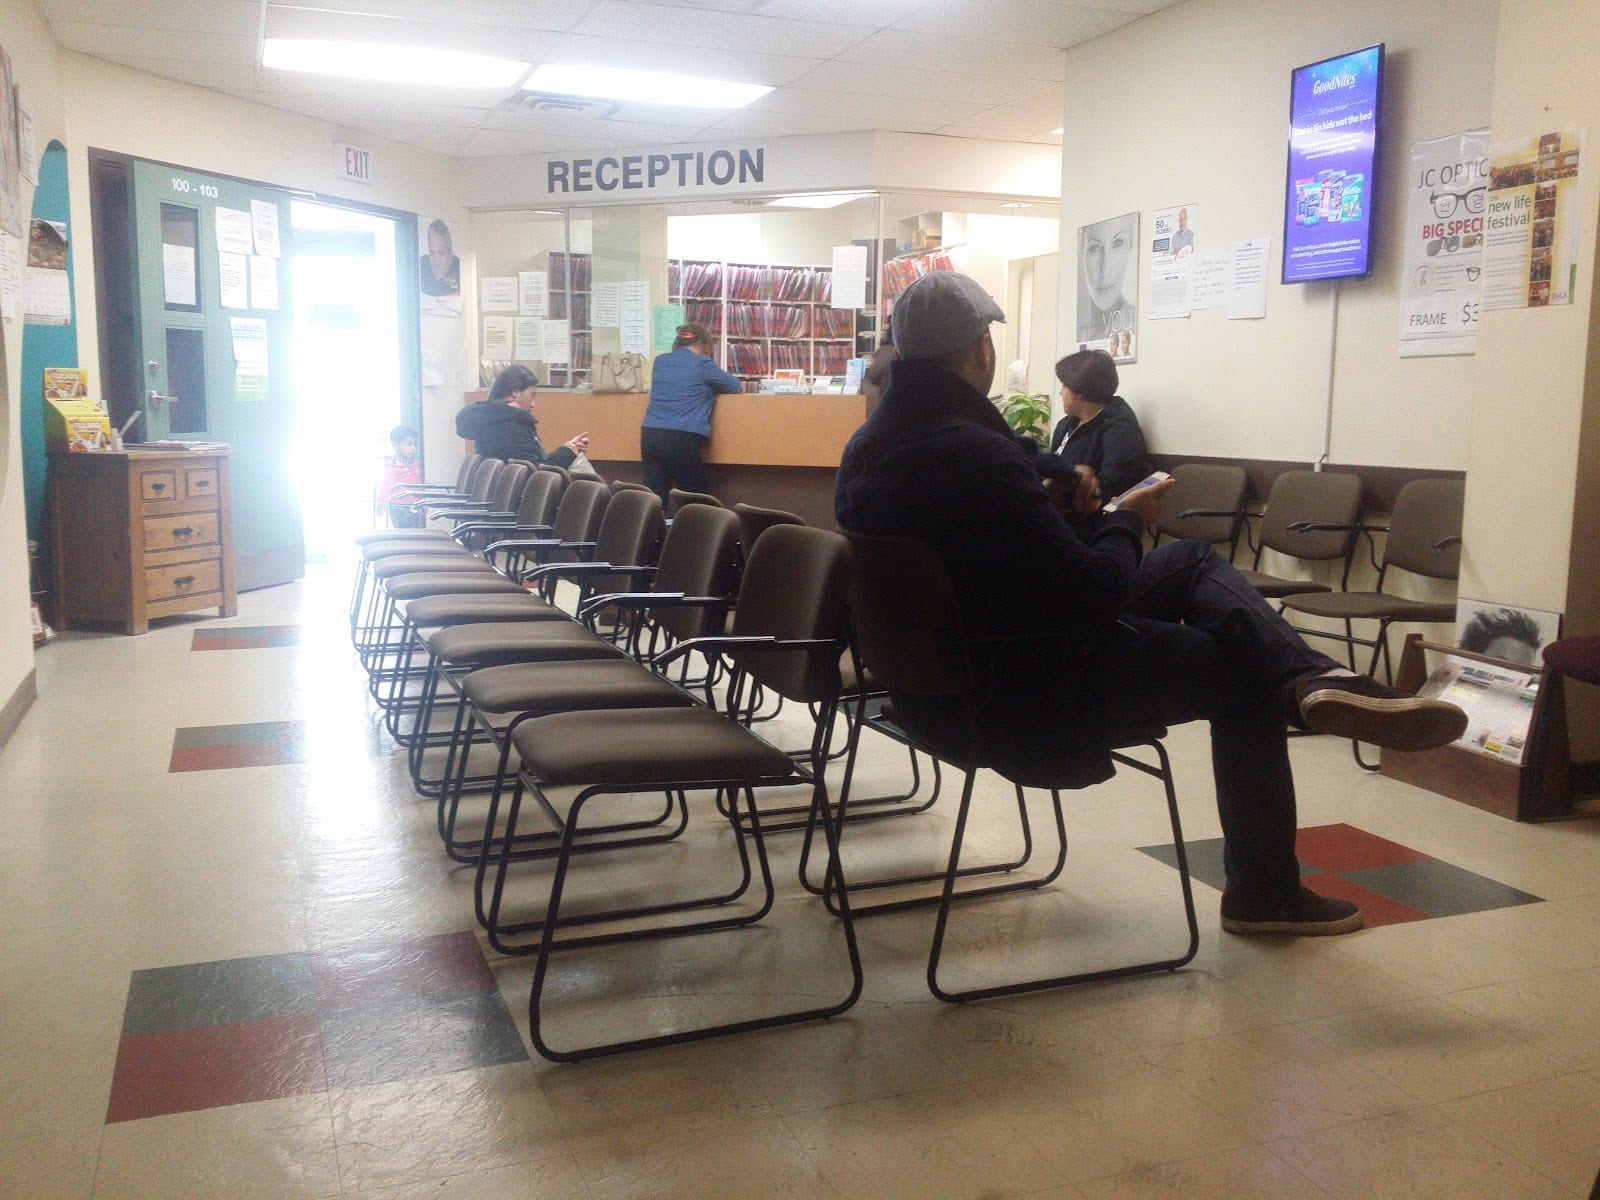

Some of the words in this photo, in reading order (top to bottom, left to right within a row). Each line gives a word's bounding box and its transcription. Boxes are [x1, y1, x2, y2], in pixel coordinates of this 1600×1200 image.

[1314, 72, 1356, 95] GoodNites
[346, 147, 370, 179] EXIT
[547, 148, 765, 193] RECEPTION
[1417, 168, 1436, 189] JC
[1440, 158, 1489, 184] OPTIC
[171, 178, 189, 193] 100
[200, 184, 218, 198] 103
[1488, 200, 1511, 214] new
[1514, 194, 1532, 210] life
[1155, 220, 1165, 229] 50
[1422, 222, 1445, 240] BIG
[1447, 217, 1484, 236] SPECI
[1487, 210, 1531, 230] festival
[1410, 312, 1447, 326] FRAME
